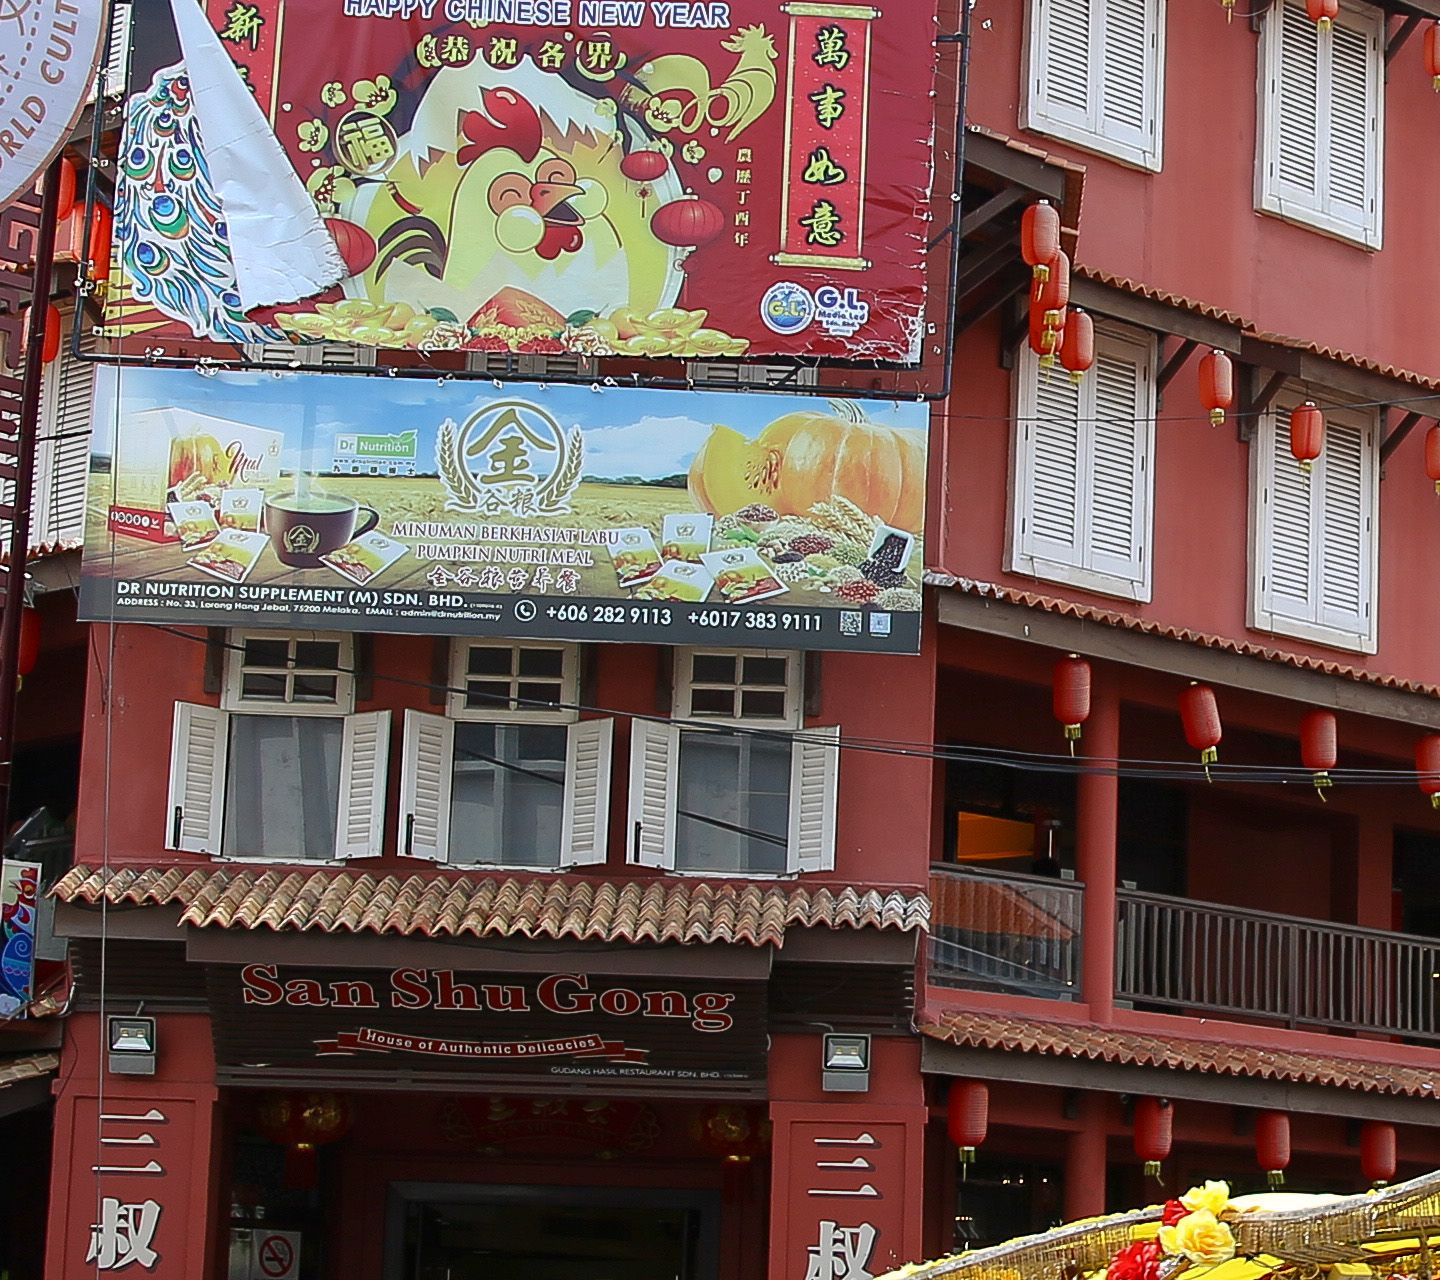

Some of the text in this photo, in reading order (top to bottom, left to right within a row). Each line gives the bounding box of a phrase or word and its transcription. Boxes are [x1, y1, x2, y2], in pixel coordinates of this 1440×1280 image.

[577, 0, 653, 27] NEW
[656, 0, 731, 29] YEAR
[440, 35, 614, 70] 恭祝各界
[338, 117, 397, 168] 福
[801, 26, 850, 248] 萬事如意
[817, 288, 867, 312] G.L.
[340, 439, 410, 453] Dr Nutrition
[466, 408, 557, 485] 金
[392, 521, 621, 546] MINUMAN BERKHASIAT LABU
[415, 543, 594, 566] PUMPKIN NUTRI MEAL
[116, 581, 142, 596] DR
[145, 582, 235, 600] NUTRITION
[238, 586, 345, 604] SUPPLEMENT
[347, 590, 379, 607] (M)
[382, 592, 424, 608] SDN.
[427, 593, 469, 609] BHD.
[116, 597, 159, 608] ADDRESS
[200, 600, 233, 612] Lorong
[234, 602, 260, 612] Hang
[293, 604, 321, 614] 75200
[365, 607, 394, 617] EMAIL
[545, 604, 672, 626] +606 282 9113
[686, 609, 823, 632] +6017 383 9111
[240, 962, 737, 1034] San Shu Gong
[365, 1029, 598, 1056] House of Authentic Delicacies
[550, 1066, 592, 1075] GUDANG
[592, 1068, 617, 1076] HASIL
[619, 1068, 676, 1077] RESTAURANT
